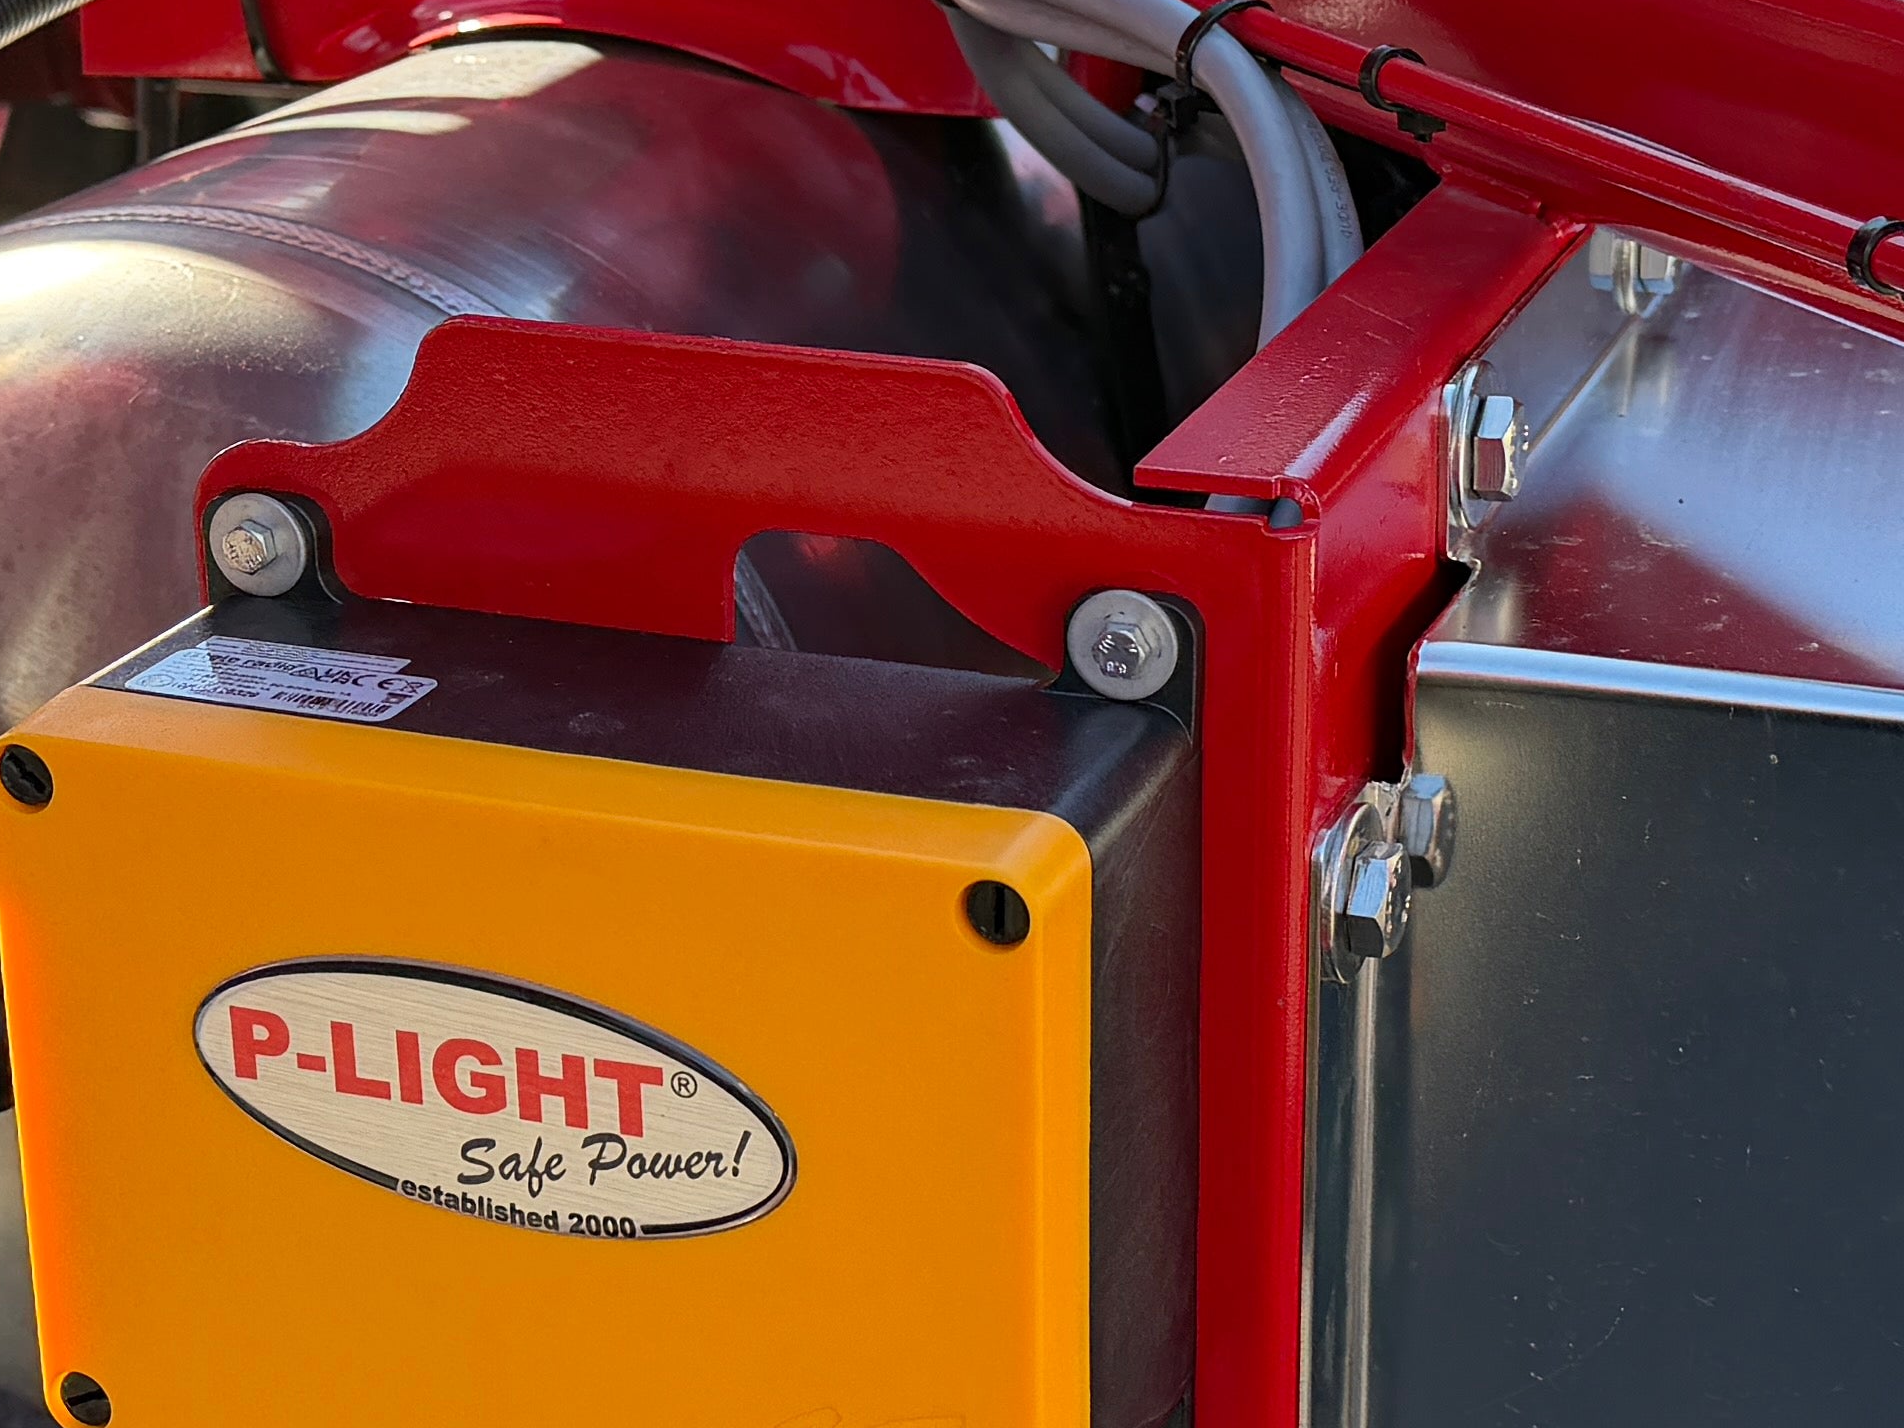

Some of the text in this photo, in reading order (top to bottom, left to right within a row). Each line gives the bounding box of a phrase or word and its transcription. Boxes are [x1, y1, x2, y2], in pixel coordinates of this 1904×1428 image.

[457, 1130, 752, 1198] Safe Power!
[400, 1178, 637, 1239] established 2000
